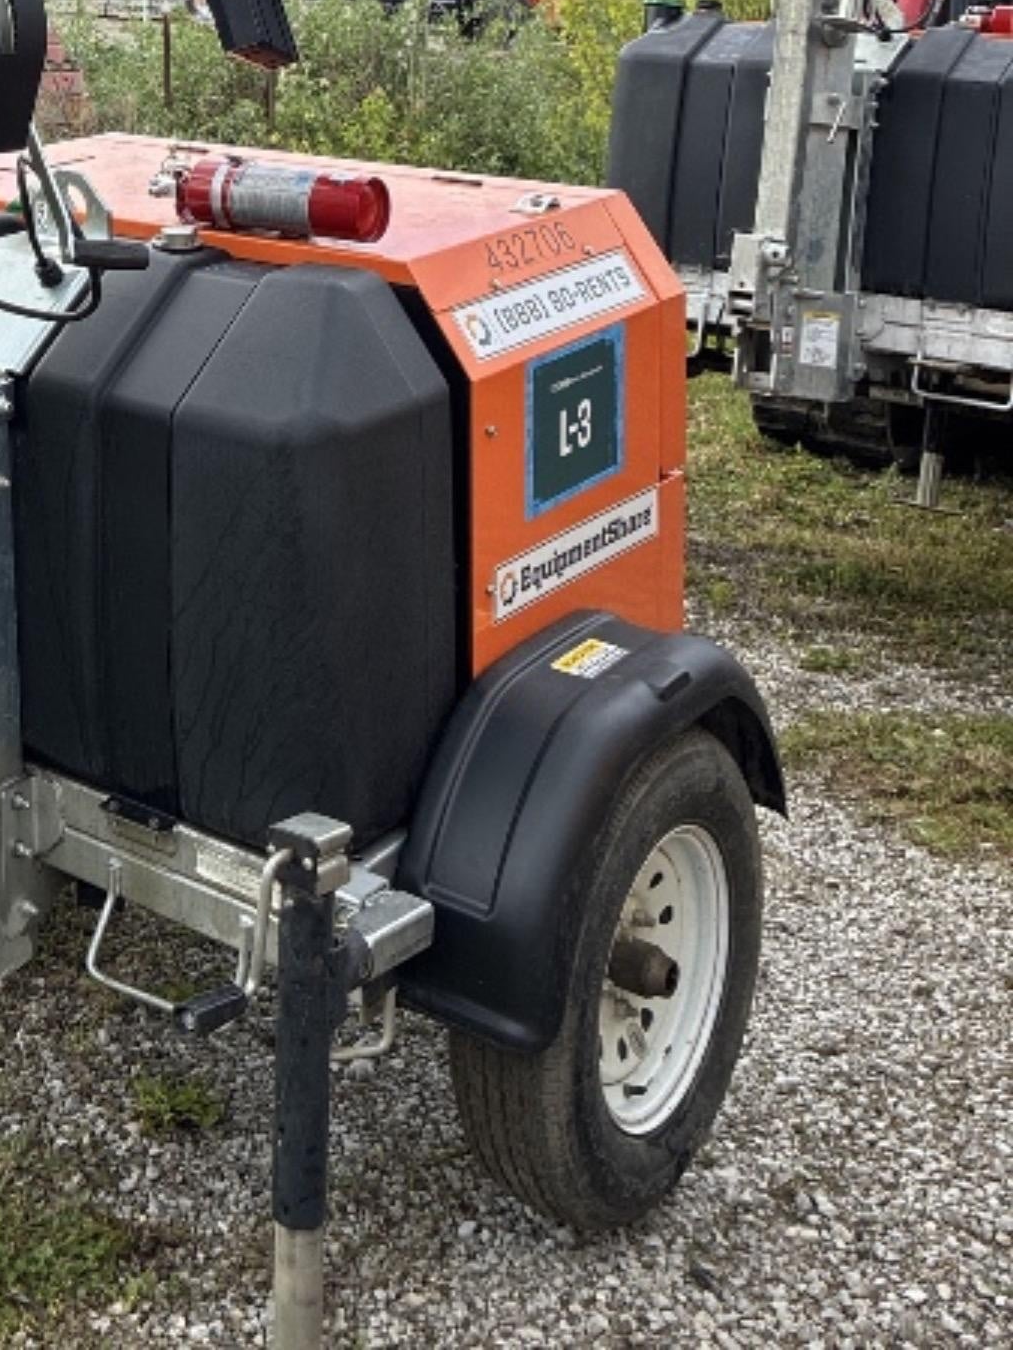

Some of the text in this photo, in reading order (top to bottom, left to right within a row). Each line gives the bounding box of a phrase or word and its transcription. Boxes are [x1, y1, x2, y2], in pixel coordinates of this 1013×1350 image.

[485, 222, 576, 272] 432706
[559, 398, 592, 457] L-3
[521, 506, 652, 592] EquipmentShare
